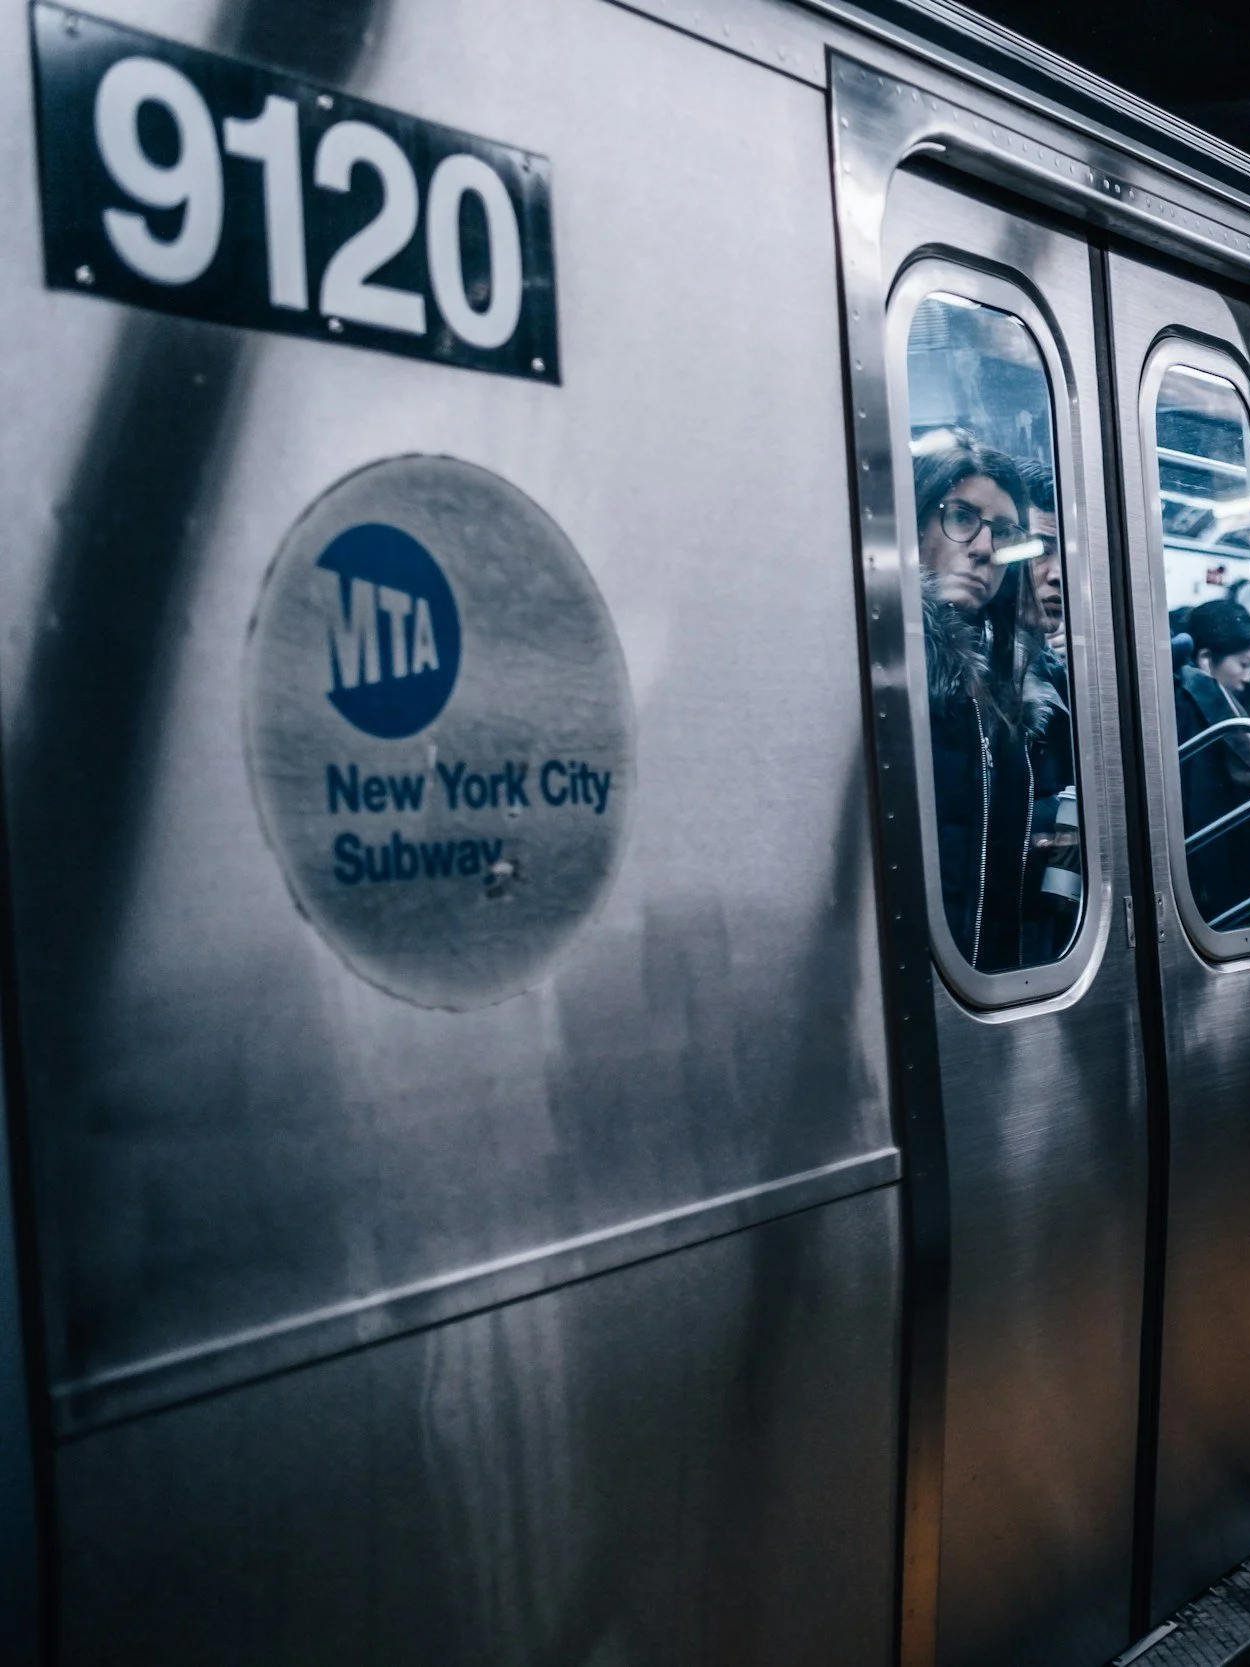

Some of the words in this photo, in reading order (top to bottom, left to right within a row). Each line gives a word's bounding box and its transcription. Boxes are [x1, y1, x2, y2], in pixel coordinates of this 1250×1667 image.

[93, 56, 523, 349] 9120
[320, 566, 440, 695] MTA
[327, 762, 424, 814] New
[438, 760, 530, 809] York
[540, 759, 611, 814] City
[334, 831, 504, 886] Subway
